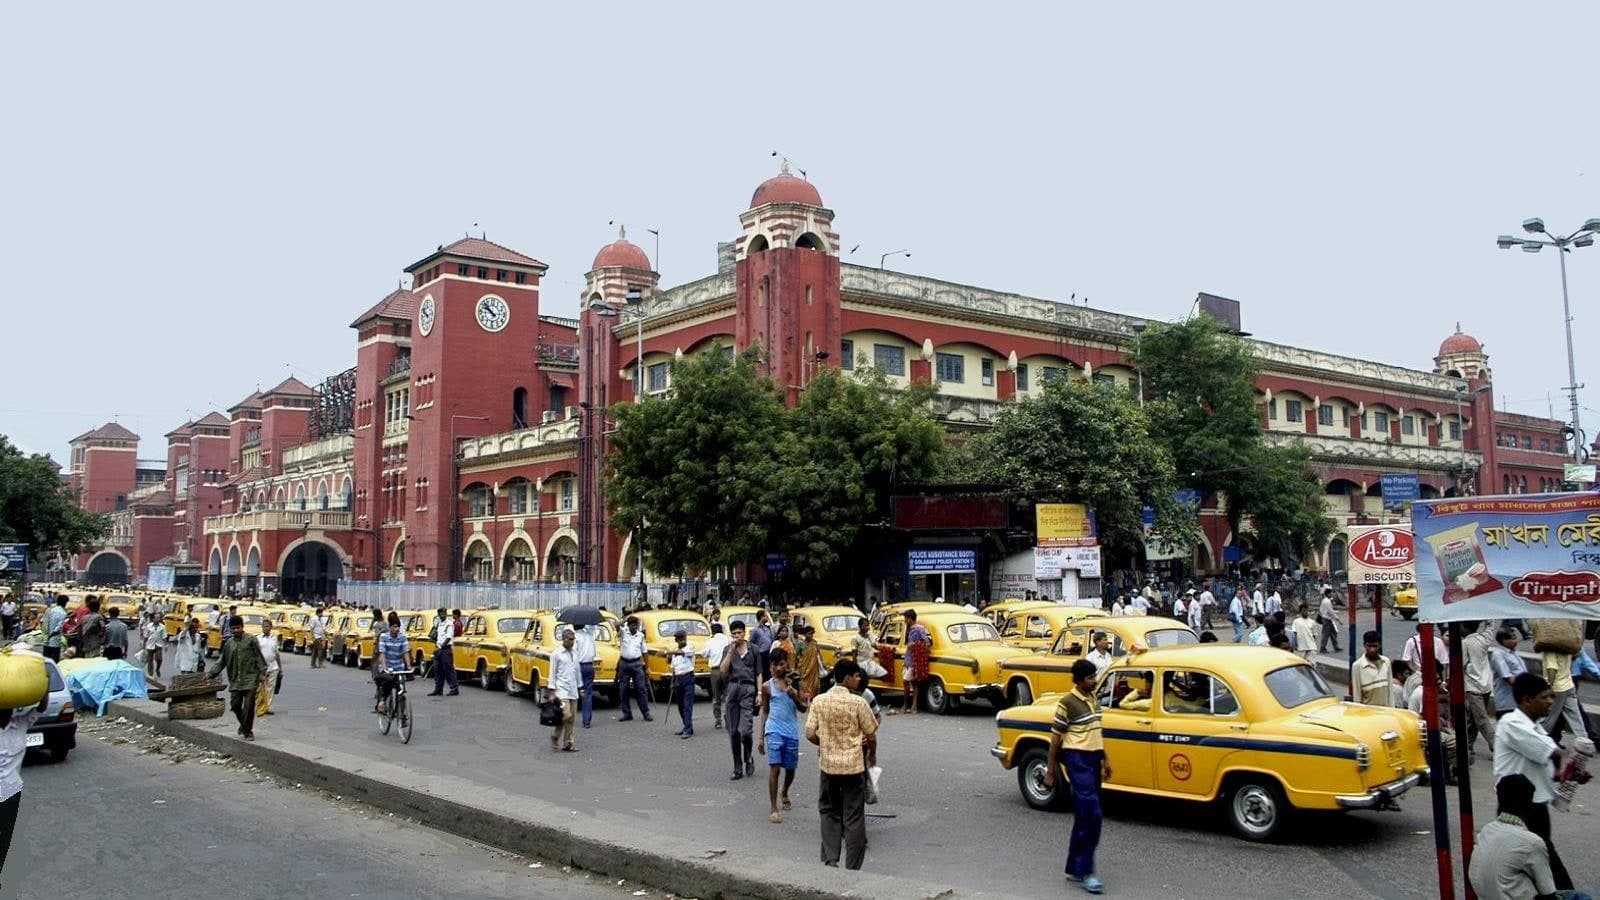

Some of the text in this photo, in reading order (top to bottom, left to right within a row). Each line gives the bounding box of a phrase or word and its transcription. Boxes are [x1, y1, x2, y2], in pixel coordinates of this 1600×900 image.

[1393, 476, 1417, 485] Parking
[1482, 522, 1549, 549] মাখন
[908, 550, 928, 559] POLICE
[928, 550, 958, 558] ASSISTANCE
[1364, 572, 1412, 581] BISCUITS
